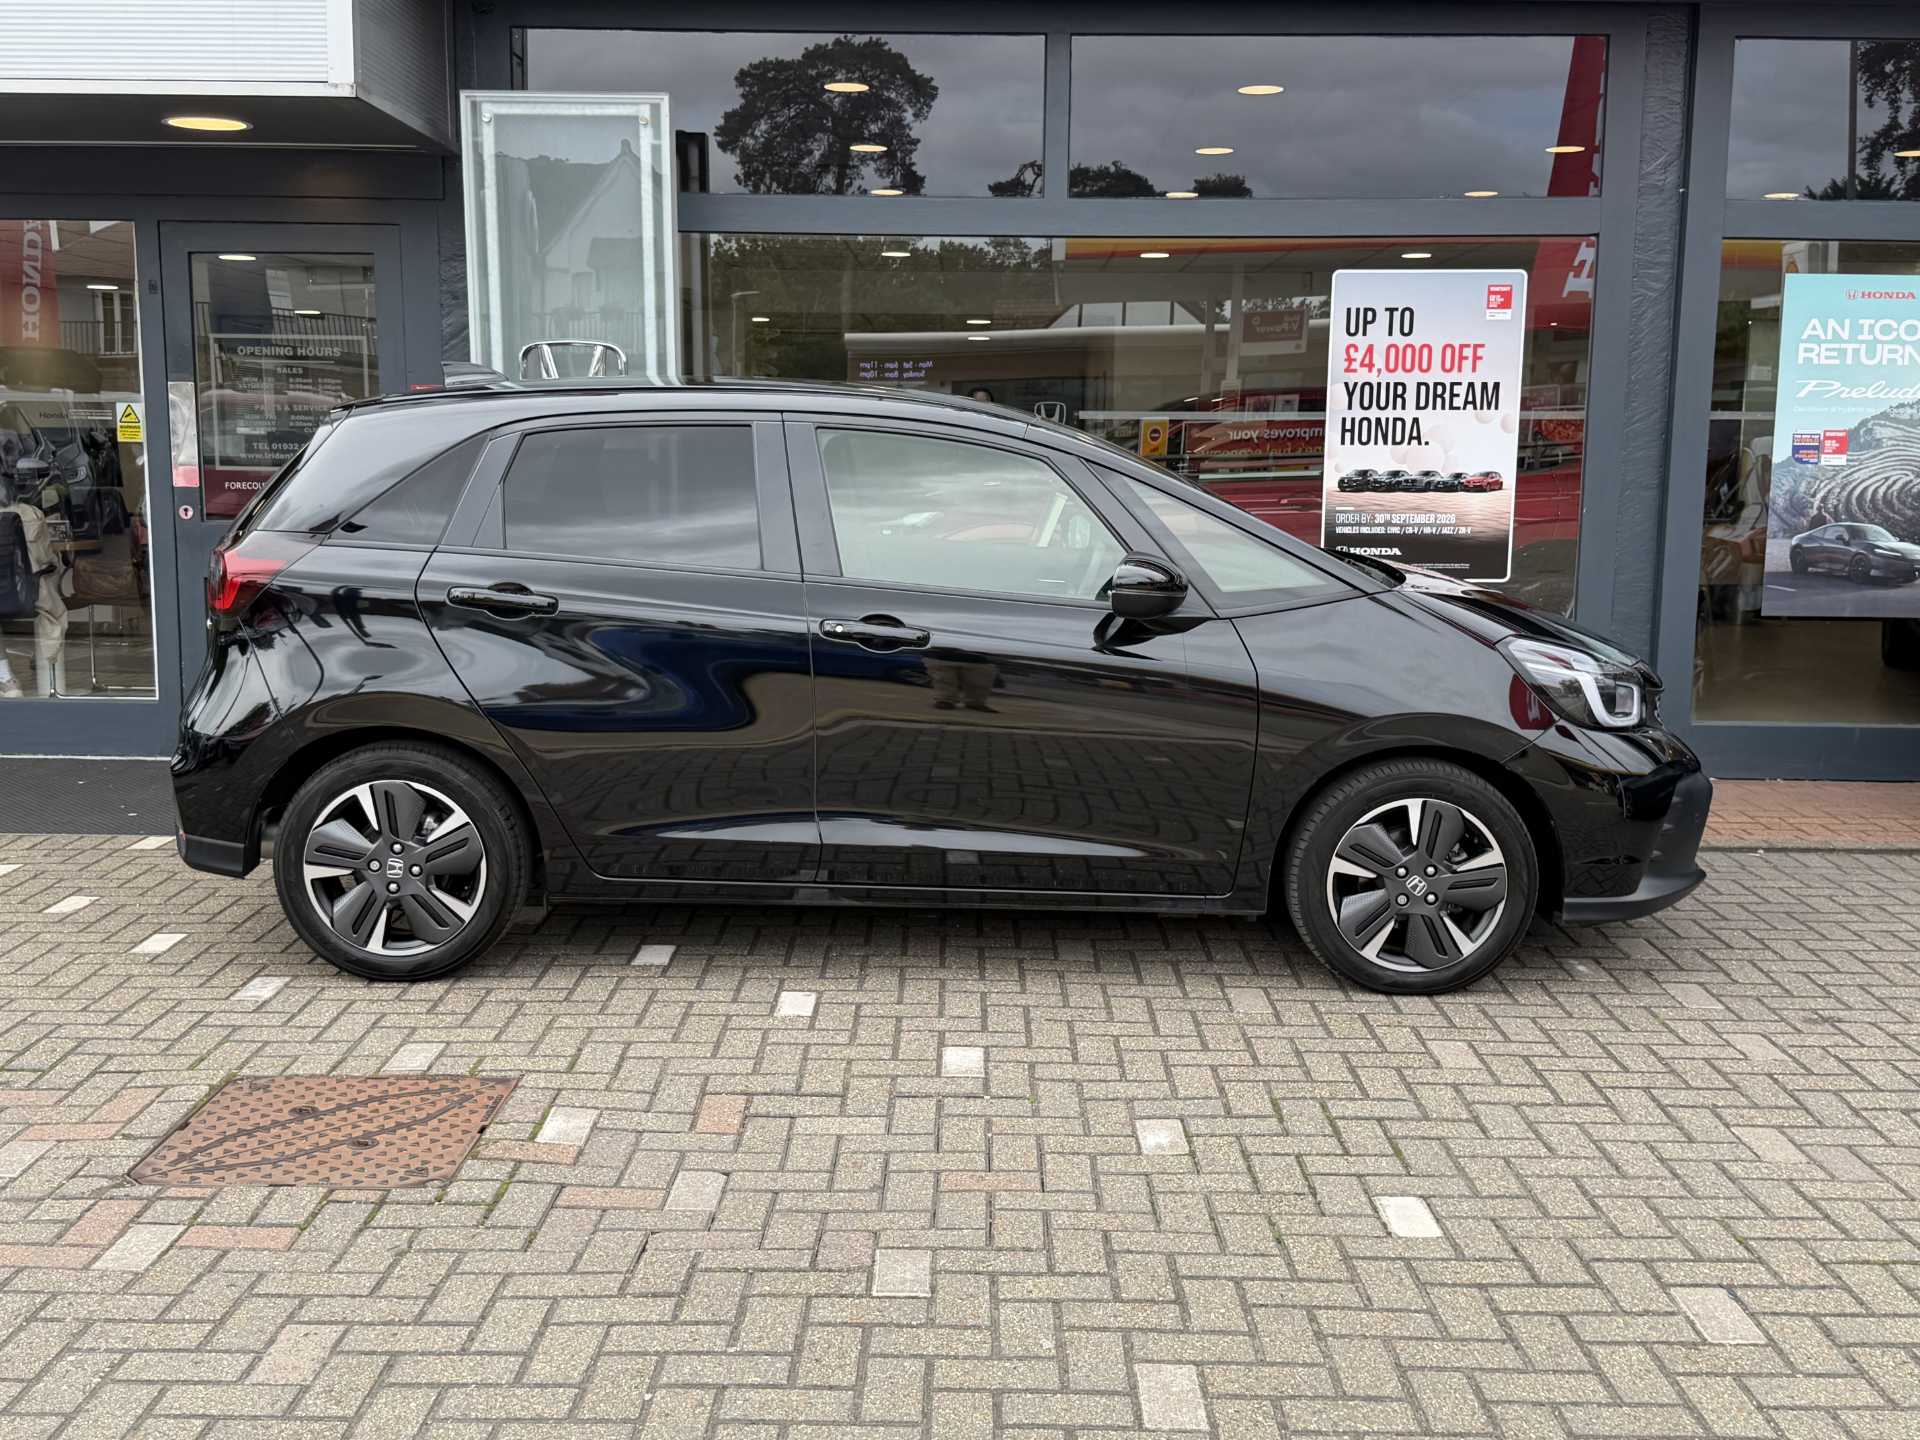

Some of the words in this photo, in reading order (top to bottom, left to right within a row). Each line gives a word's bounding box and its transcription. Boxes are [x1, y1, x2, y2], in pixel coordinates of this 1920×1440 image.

[1861, 291, 1916, 300] HONDA
[1345, 307, 1377, 337] UP
[1384, 306, 1415, 337] TO
[1801, 318, 1851, 340] AN
[237, 346, 294, 356] OPENING
[297, 346, 342, 357] HOURS
[1343, 343, 1433, 378] £4,000
[1440, 343, 1486, 374] OFF
[1343, 381, 1407, 411] YOUR
[1415, 381, 1501, 411] DREAM
[1340, 416, 1430, 446] HONDA.
[253, 442, 270, 450] TEL
[1335, 513, 1360, 524] ORDER
[1361, 513, 1374, 524] BY:
[1391, 513, 1436, 524] SEPTEMBER
[1335, 526, 1359, 534] VEHICLES
[1349, 547, 1402, 556] HONDA
